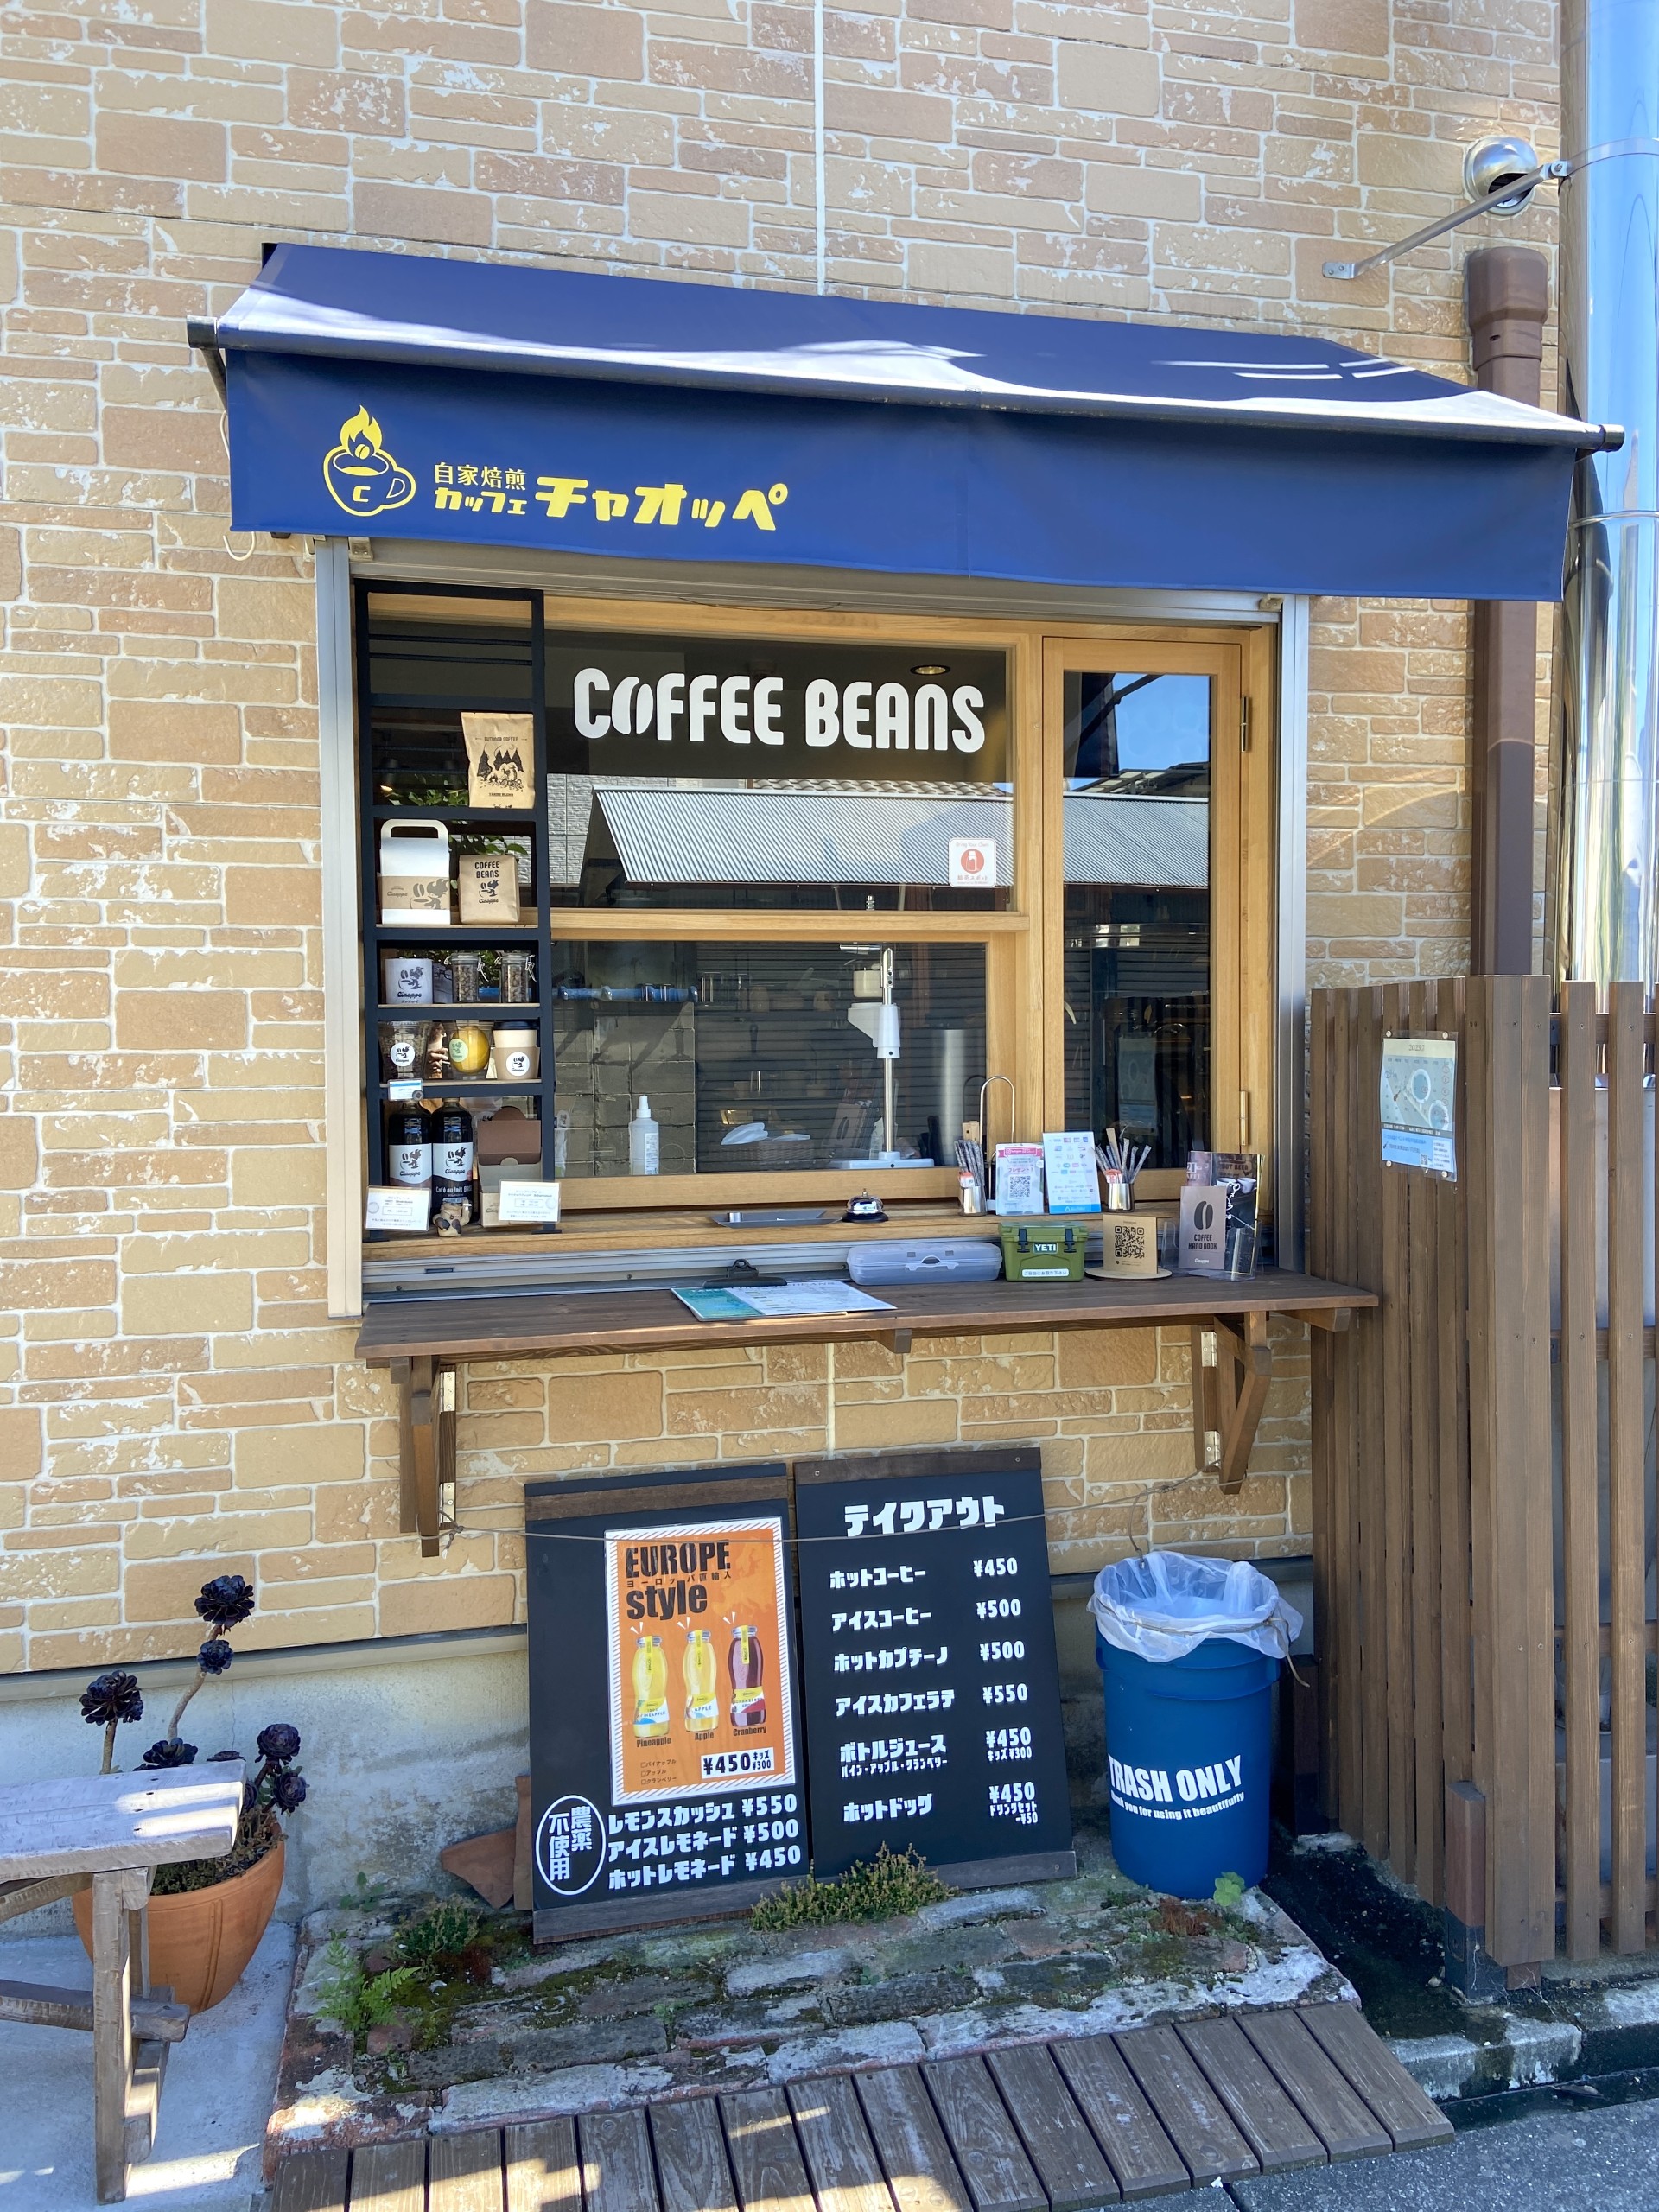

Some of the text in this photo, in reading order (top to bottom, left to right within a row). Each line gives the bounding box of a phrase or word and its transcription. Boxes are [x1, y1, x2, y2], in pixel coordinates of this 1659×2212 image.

[435, 461, 526, 491] 自家焙煎
[435, 476, 788, 531] カッフェ チャオッペ
[574, 667, 986, 753] COFFEE BEANS
[474, 861, 499, 869] COFFEE
[476, 869, 499, 879] BEANS
[844, 1495, 1005, 1537] テイクアウト
[625, 1539, 731, 1579] EUROPE
[830, 1557, 1019, 1590] ホットコーヒー ¥450
[626, 1571, 732, 1588] ヨーロッパ直輸入
[626, 1580, 708, 1620] style
[831, 1598, 1022, 1633] アイスコーヒー ¥500
[833, 1639, 1026, 1673] ホットカプチーノ ¥500
[836, 1682, 1029, 1717] アイスカフェラテ ¥550
[636, 1737, 671, 1748] Pineapple
[695, 1732, 715, 1741] Apple
[733, 1726, 767, 1737] Cranberry
[840, 1726, 1032, 1763] ボトルジュース ¥450
[703, 1752, 751, 1775] ¥450
[752, 1759, 772, 1770] ¥300
[753, 1750, 770, 1760] キッズ
[841, 1756, 948, 1778] パイン・アップル・クランベリー
[987, 1746, 1033, 1762] キッズ ¥300
[1108, 1753, 1241, 1802] TRASH ONLY
[608, 1793, 798, 1835] レモンスカッシュ ¥550
[843, 1781, 1035, 1822] ホットドッグ ¥450
[989, 1800, 1038, 1816] ドリンクセット
[1123, 1802, 1138, 1815] you
[1139, 1806, 1152, 1818] for
[1154, 1808, 1183, 1821] using
[1183, 1808, 1192, 1819] it
[1192, 1791, 1244, 1818] beautifully
[570, 1805, 593, 1851] 農薬
[608, 1818, 799, 1863] アイスレモネード ¥500
[549, 1812, 570, 1881] 不使用
[608, 1845, 801, 1891] ホットレモネード ¥450
